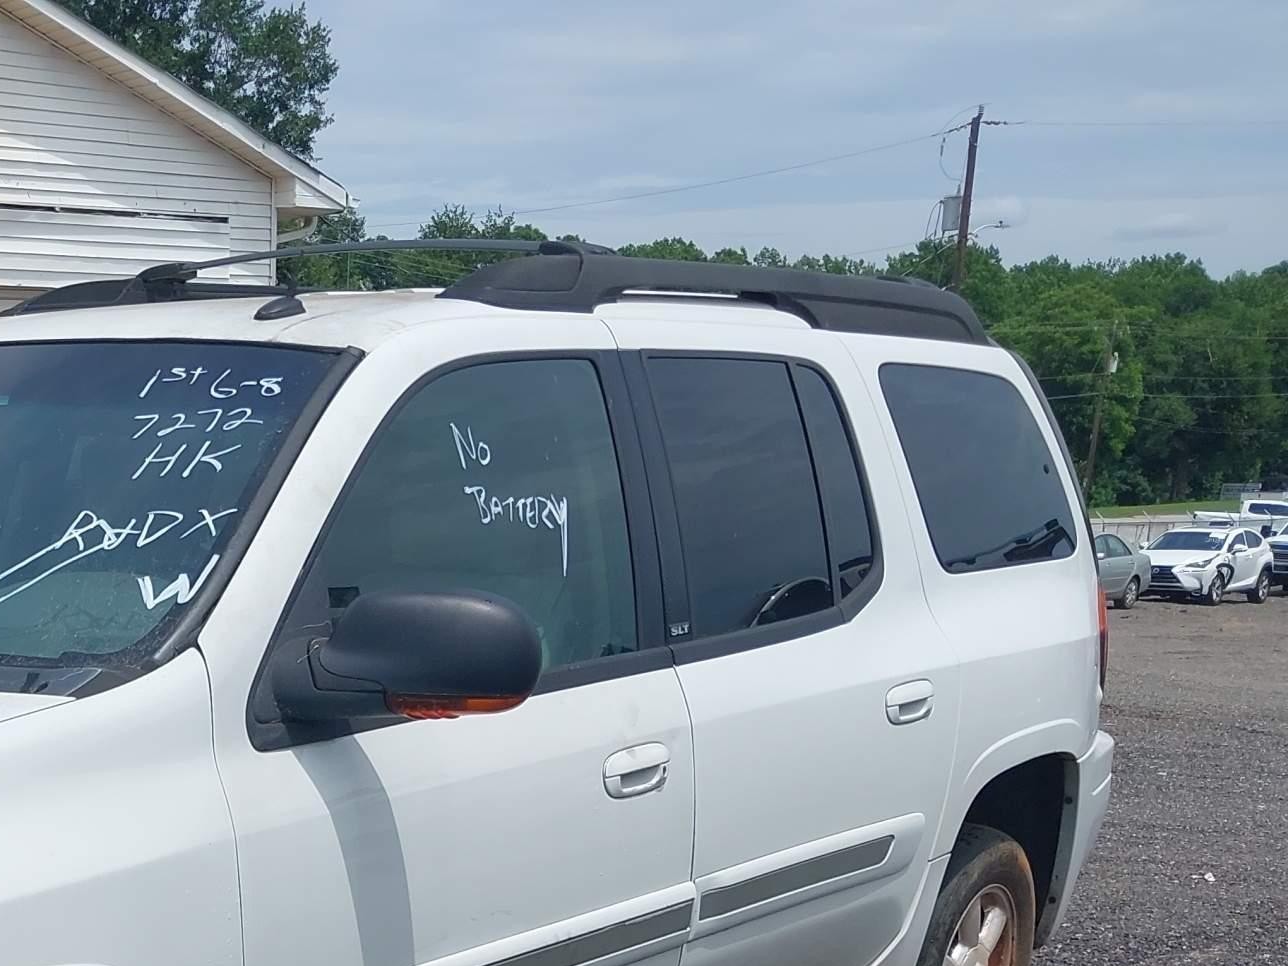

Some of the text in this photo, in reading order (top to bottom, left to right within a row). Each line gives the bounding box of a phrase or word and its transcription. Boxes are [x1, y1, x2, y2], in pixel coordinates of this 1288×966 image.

[210, 368, 284, 398] 6-8
[132, 407, 264, 439] 7272
[131, 440, 242, 479] HK
[450, 422, 491, 469] No
[463, 485, 568, 577] BATTERY
[670, 624, 689, 636] SLT
